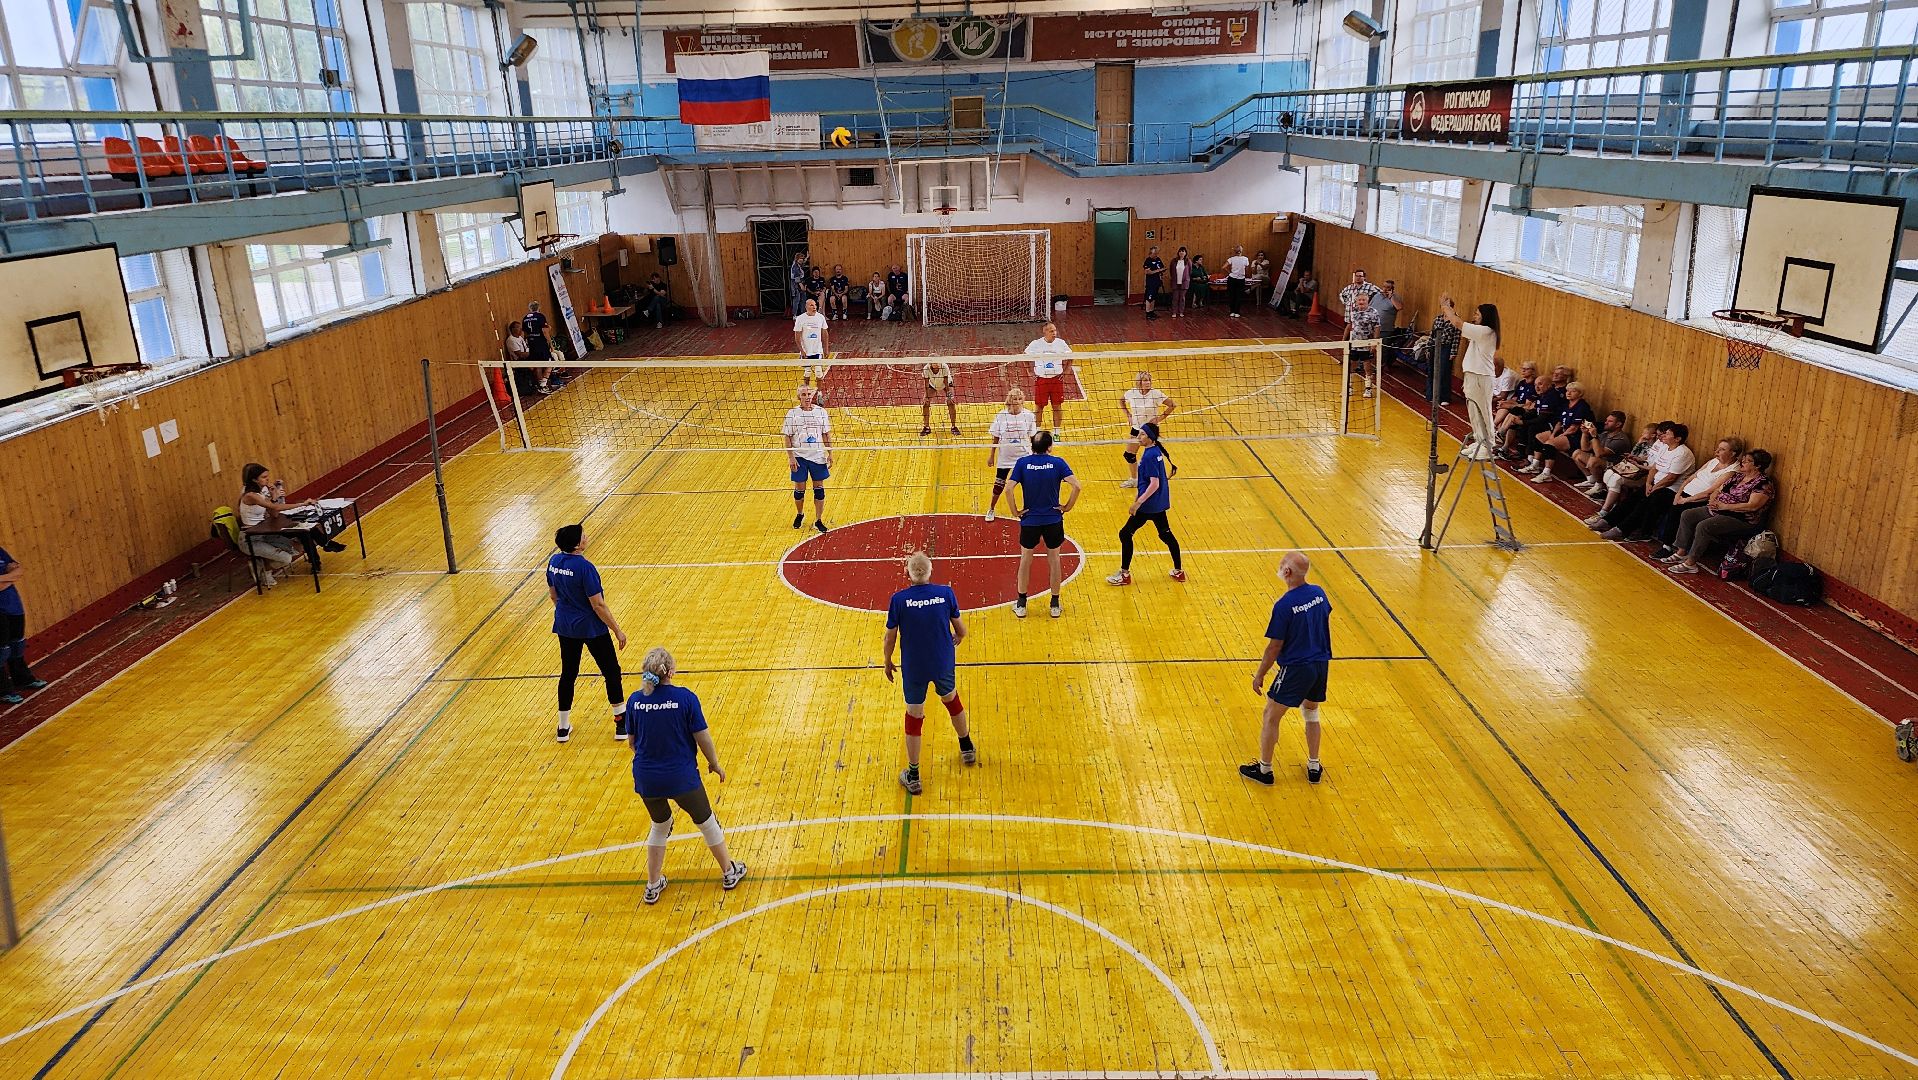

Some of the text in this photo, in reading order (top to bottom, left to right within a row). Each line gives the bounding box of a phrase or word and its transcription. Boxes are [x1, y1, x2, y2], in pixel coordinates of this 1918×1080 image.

[1084, 26, 1220, 38] ИСТОЧНИК СИЛЫ
[701, 35, 762, 44] ПРИВЕТ
[1116, 36, 1220, 48] И ЗДОРОВЬЯ!
[1443, 89, 1491, 110] НОГИНСКАЯ
[1430, 114, 1474, 134] ФЕДЕРАЦИЯ
[324, 521, 331, 534] 8
[336, 513, 342, 527] 5
[905, 596, 946, 609] Королёв
[633, 700, 679, 713] Королёв
